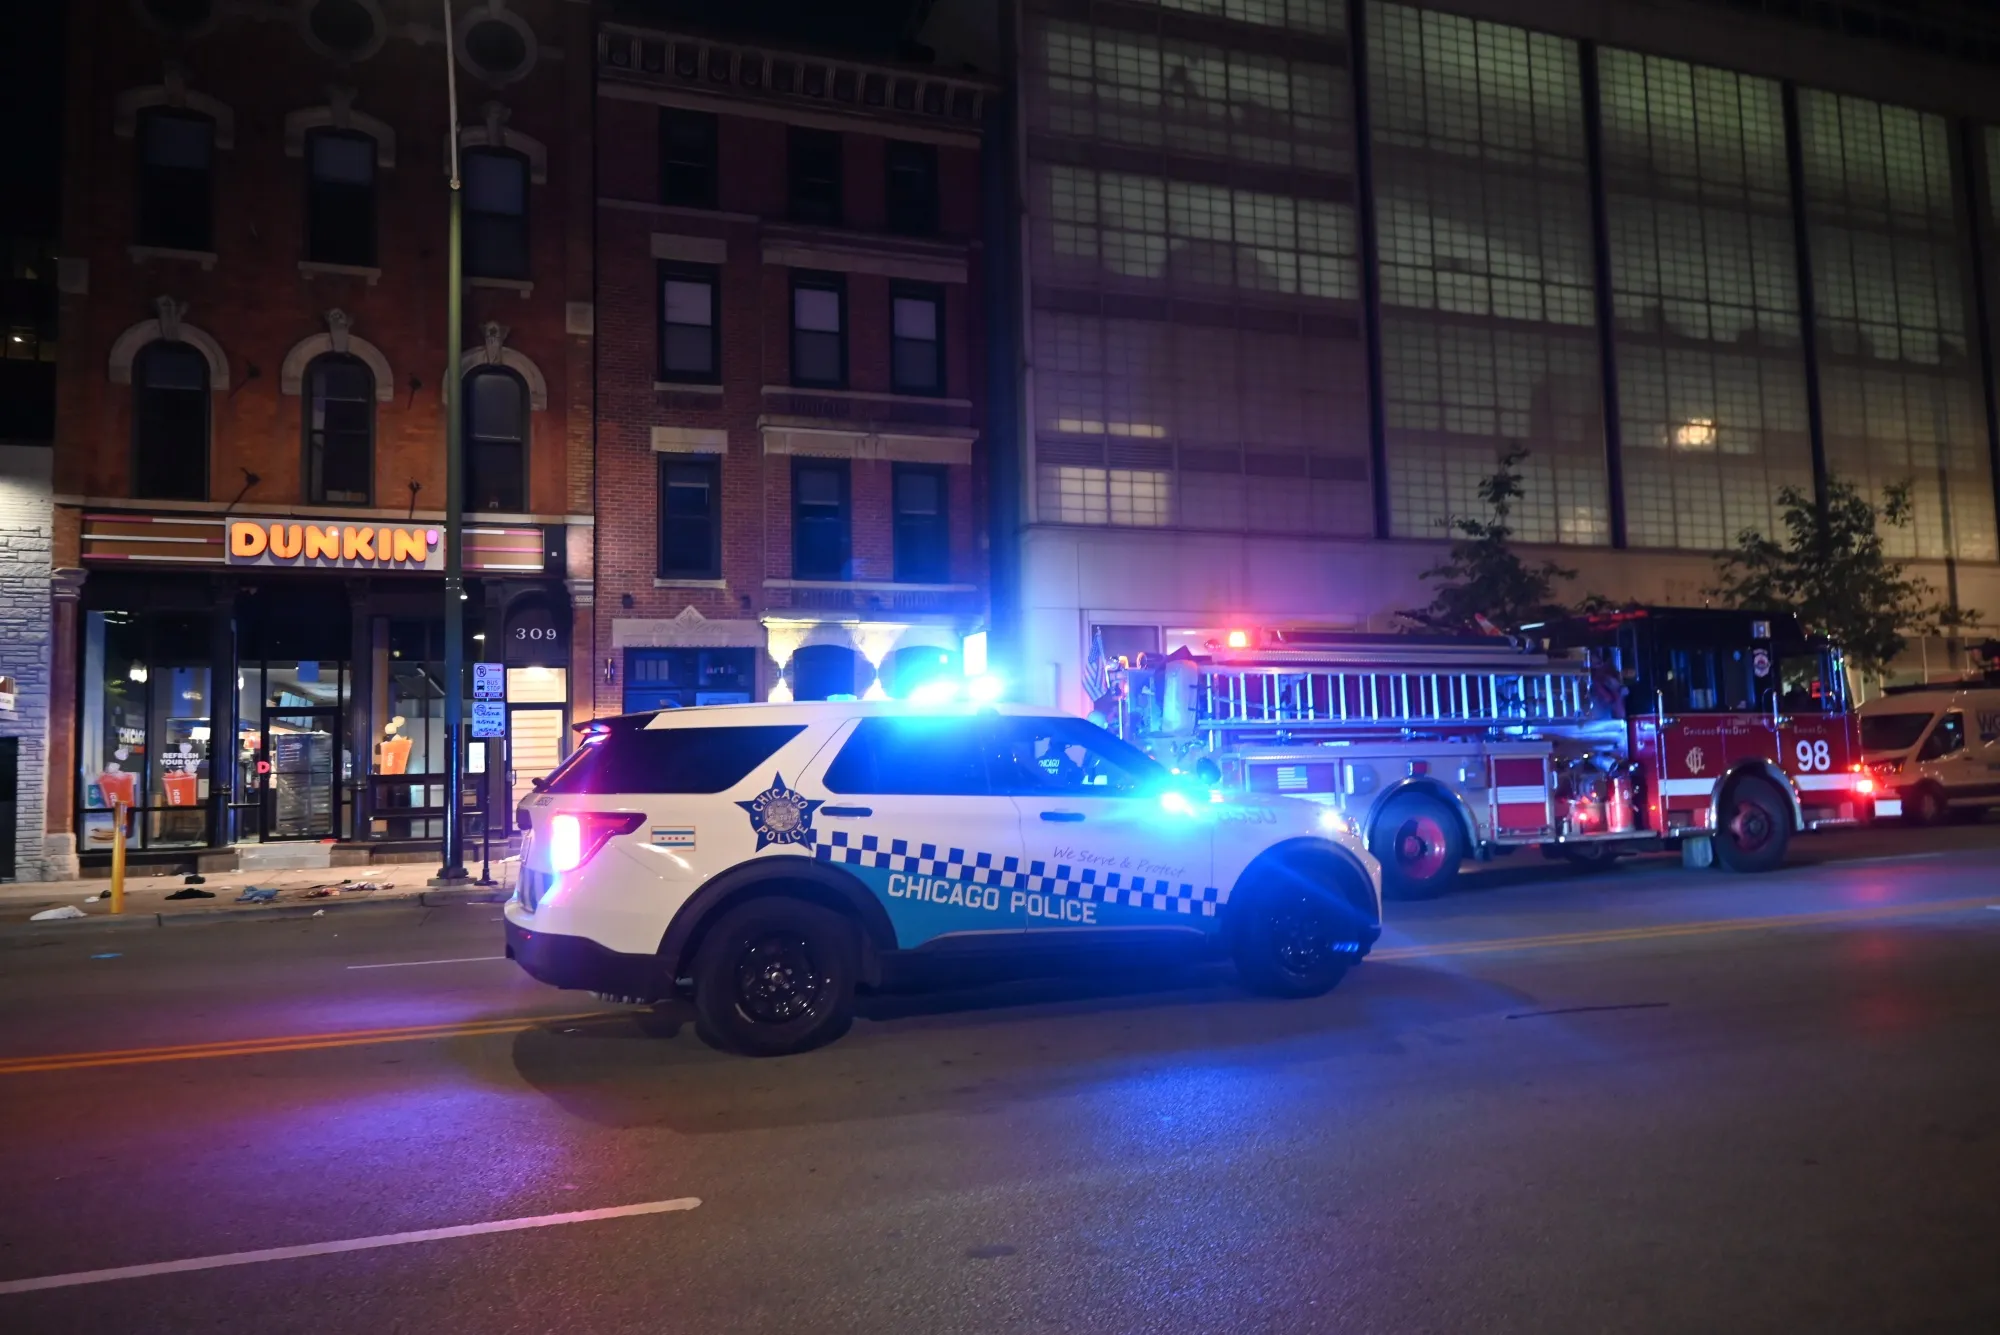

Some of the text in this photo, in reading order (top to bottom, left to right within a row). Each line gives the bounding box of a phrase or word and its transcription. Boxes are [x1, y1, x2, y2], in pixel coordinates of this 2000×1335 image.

[231, 522, 438, 562] DUNKIN'
[515, 628, 557, 640] 309
[1796, 739, 1831, 772] 98
[256, 761, 270, 774] D
[173, 789, 181, 805] ICED
[752, 788, 808, 811] CHICAGO
[757, 822, 809, 843] POLICE
[1053, 846, 1185, 878] We Serve & Protect
[887, 873, 1098, 925] CHICAGO POLICE
